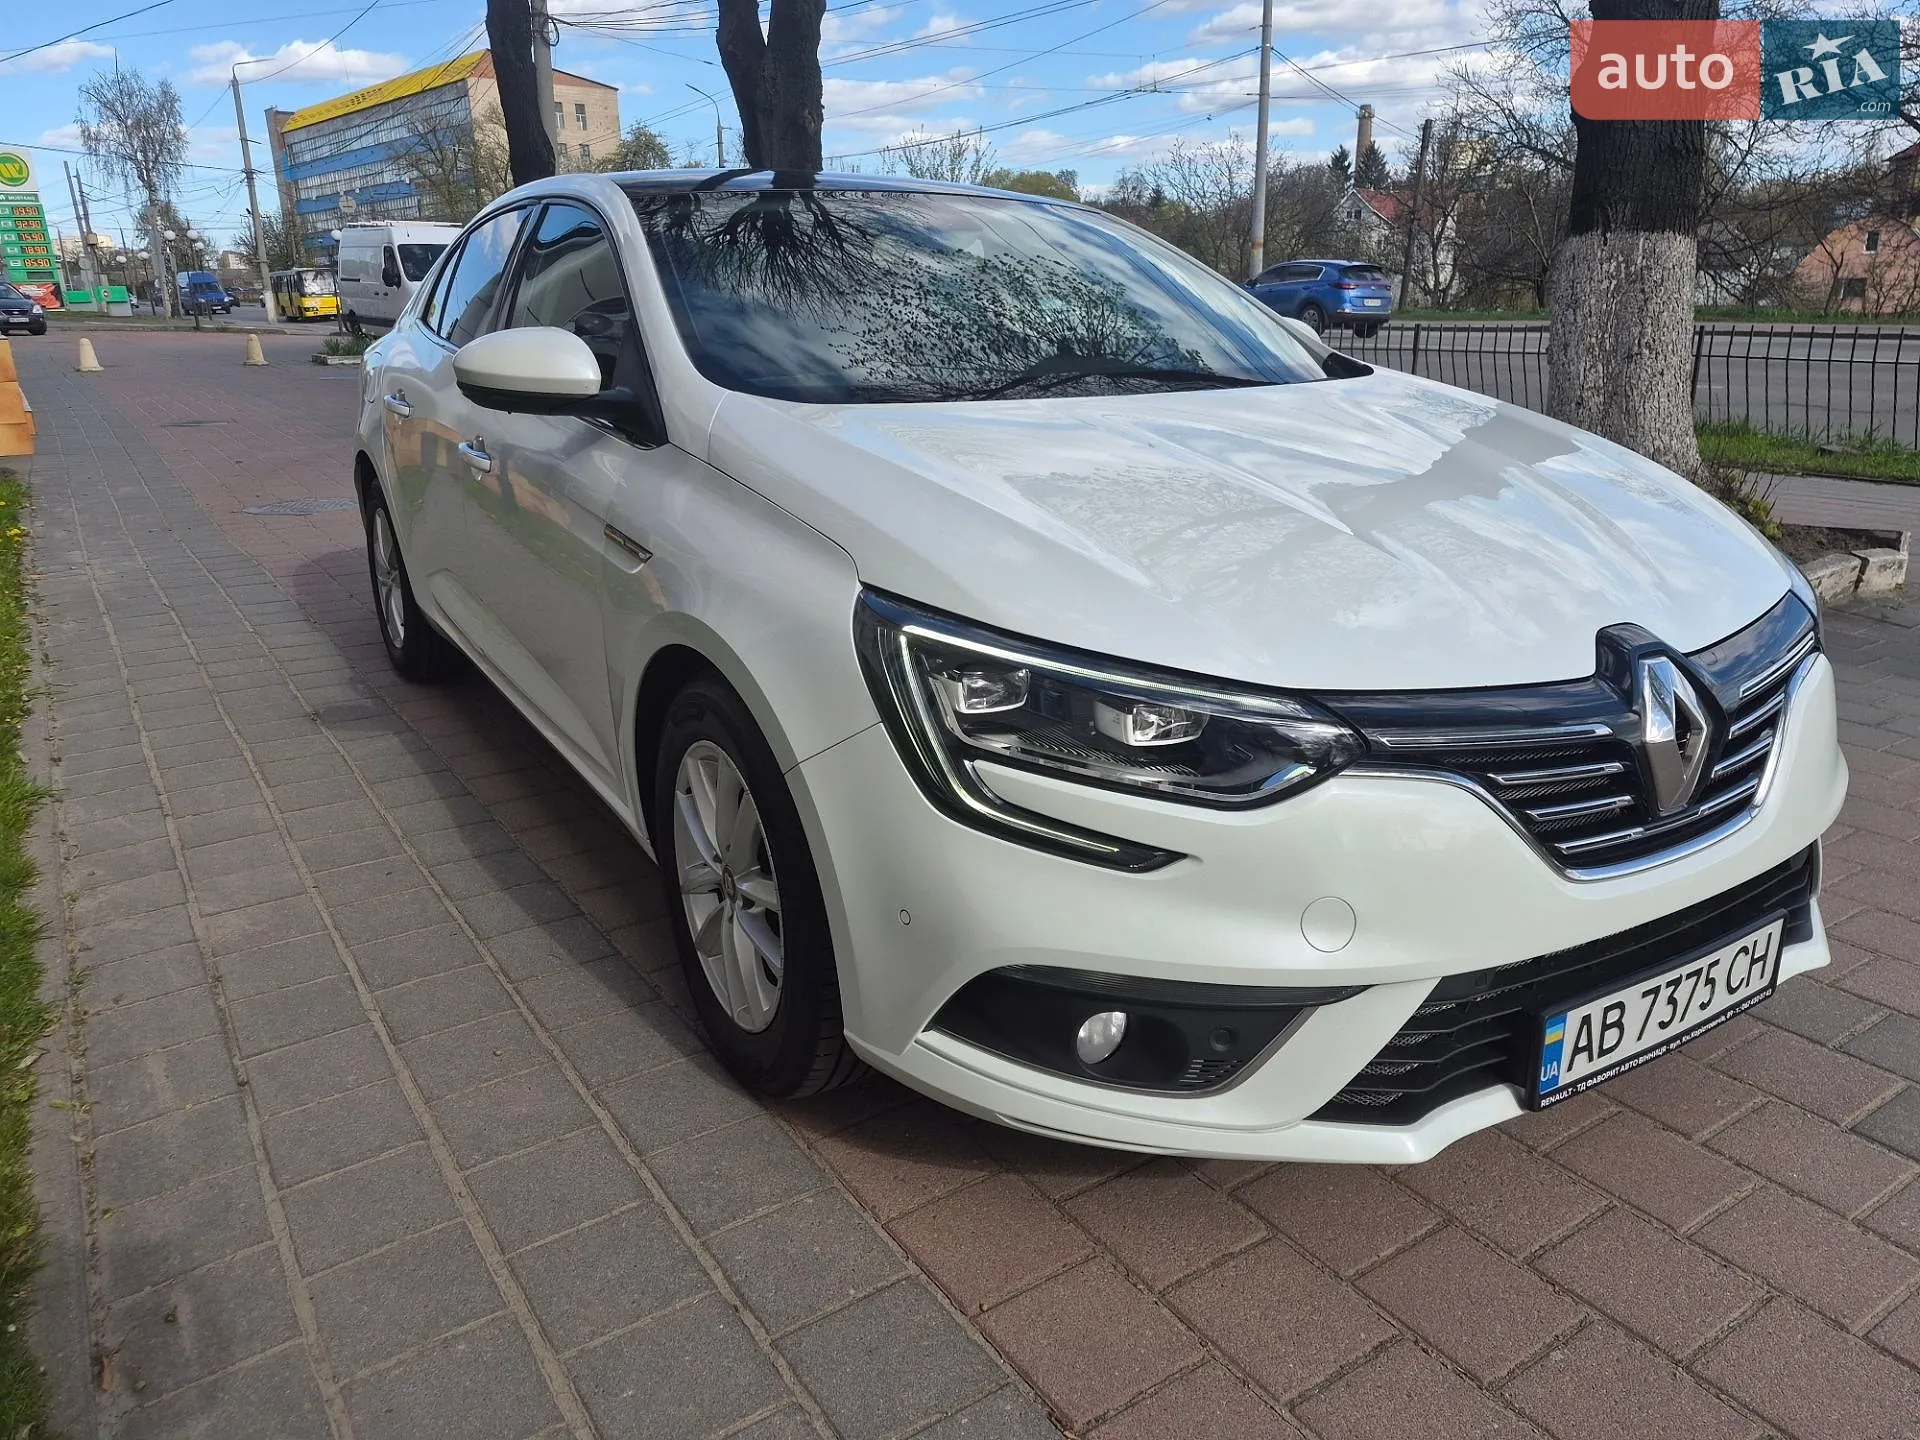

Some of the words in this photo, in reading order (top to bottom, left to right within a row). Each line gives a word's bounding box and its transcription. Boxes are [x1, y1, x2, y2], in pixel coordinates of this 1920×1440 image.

[1567, 1001, 1626, 1073] AB
[1637, 958, 1720, 1042] 7375
[1726, 932, 1773, 996] CH
[1540, 1060, 1558, 1081] UA
[1541, 1088, 1573, 1107] RENAULT
[1577, 1082, 1586, 1092] ТД
[1587, 1067, 1620, 1087] ФАВОРИТ
[1620, 1060, 1638, 1072] АВТО
[1638, 1046, 1667, 1064] ВІННИЦЯ
